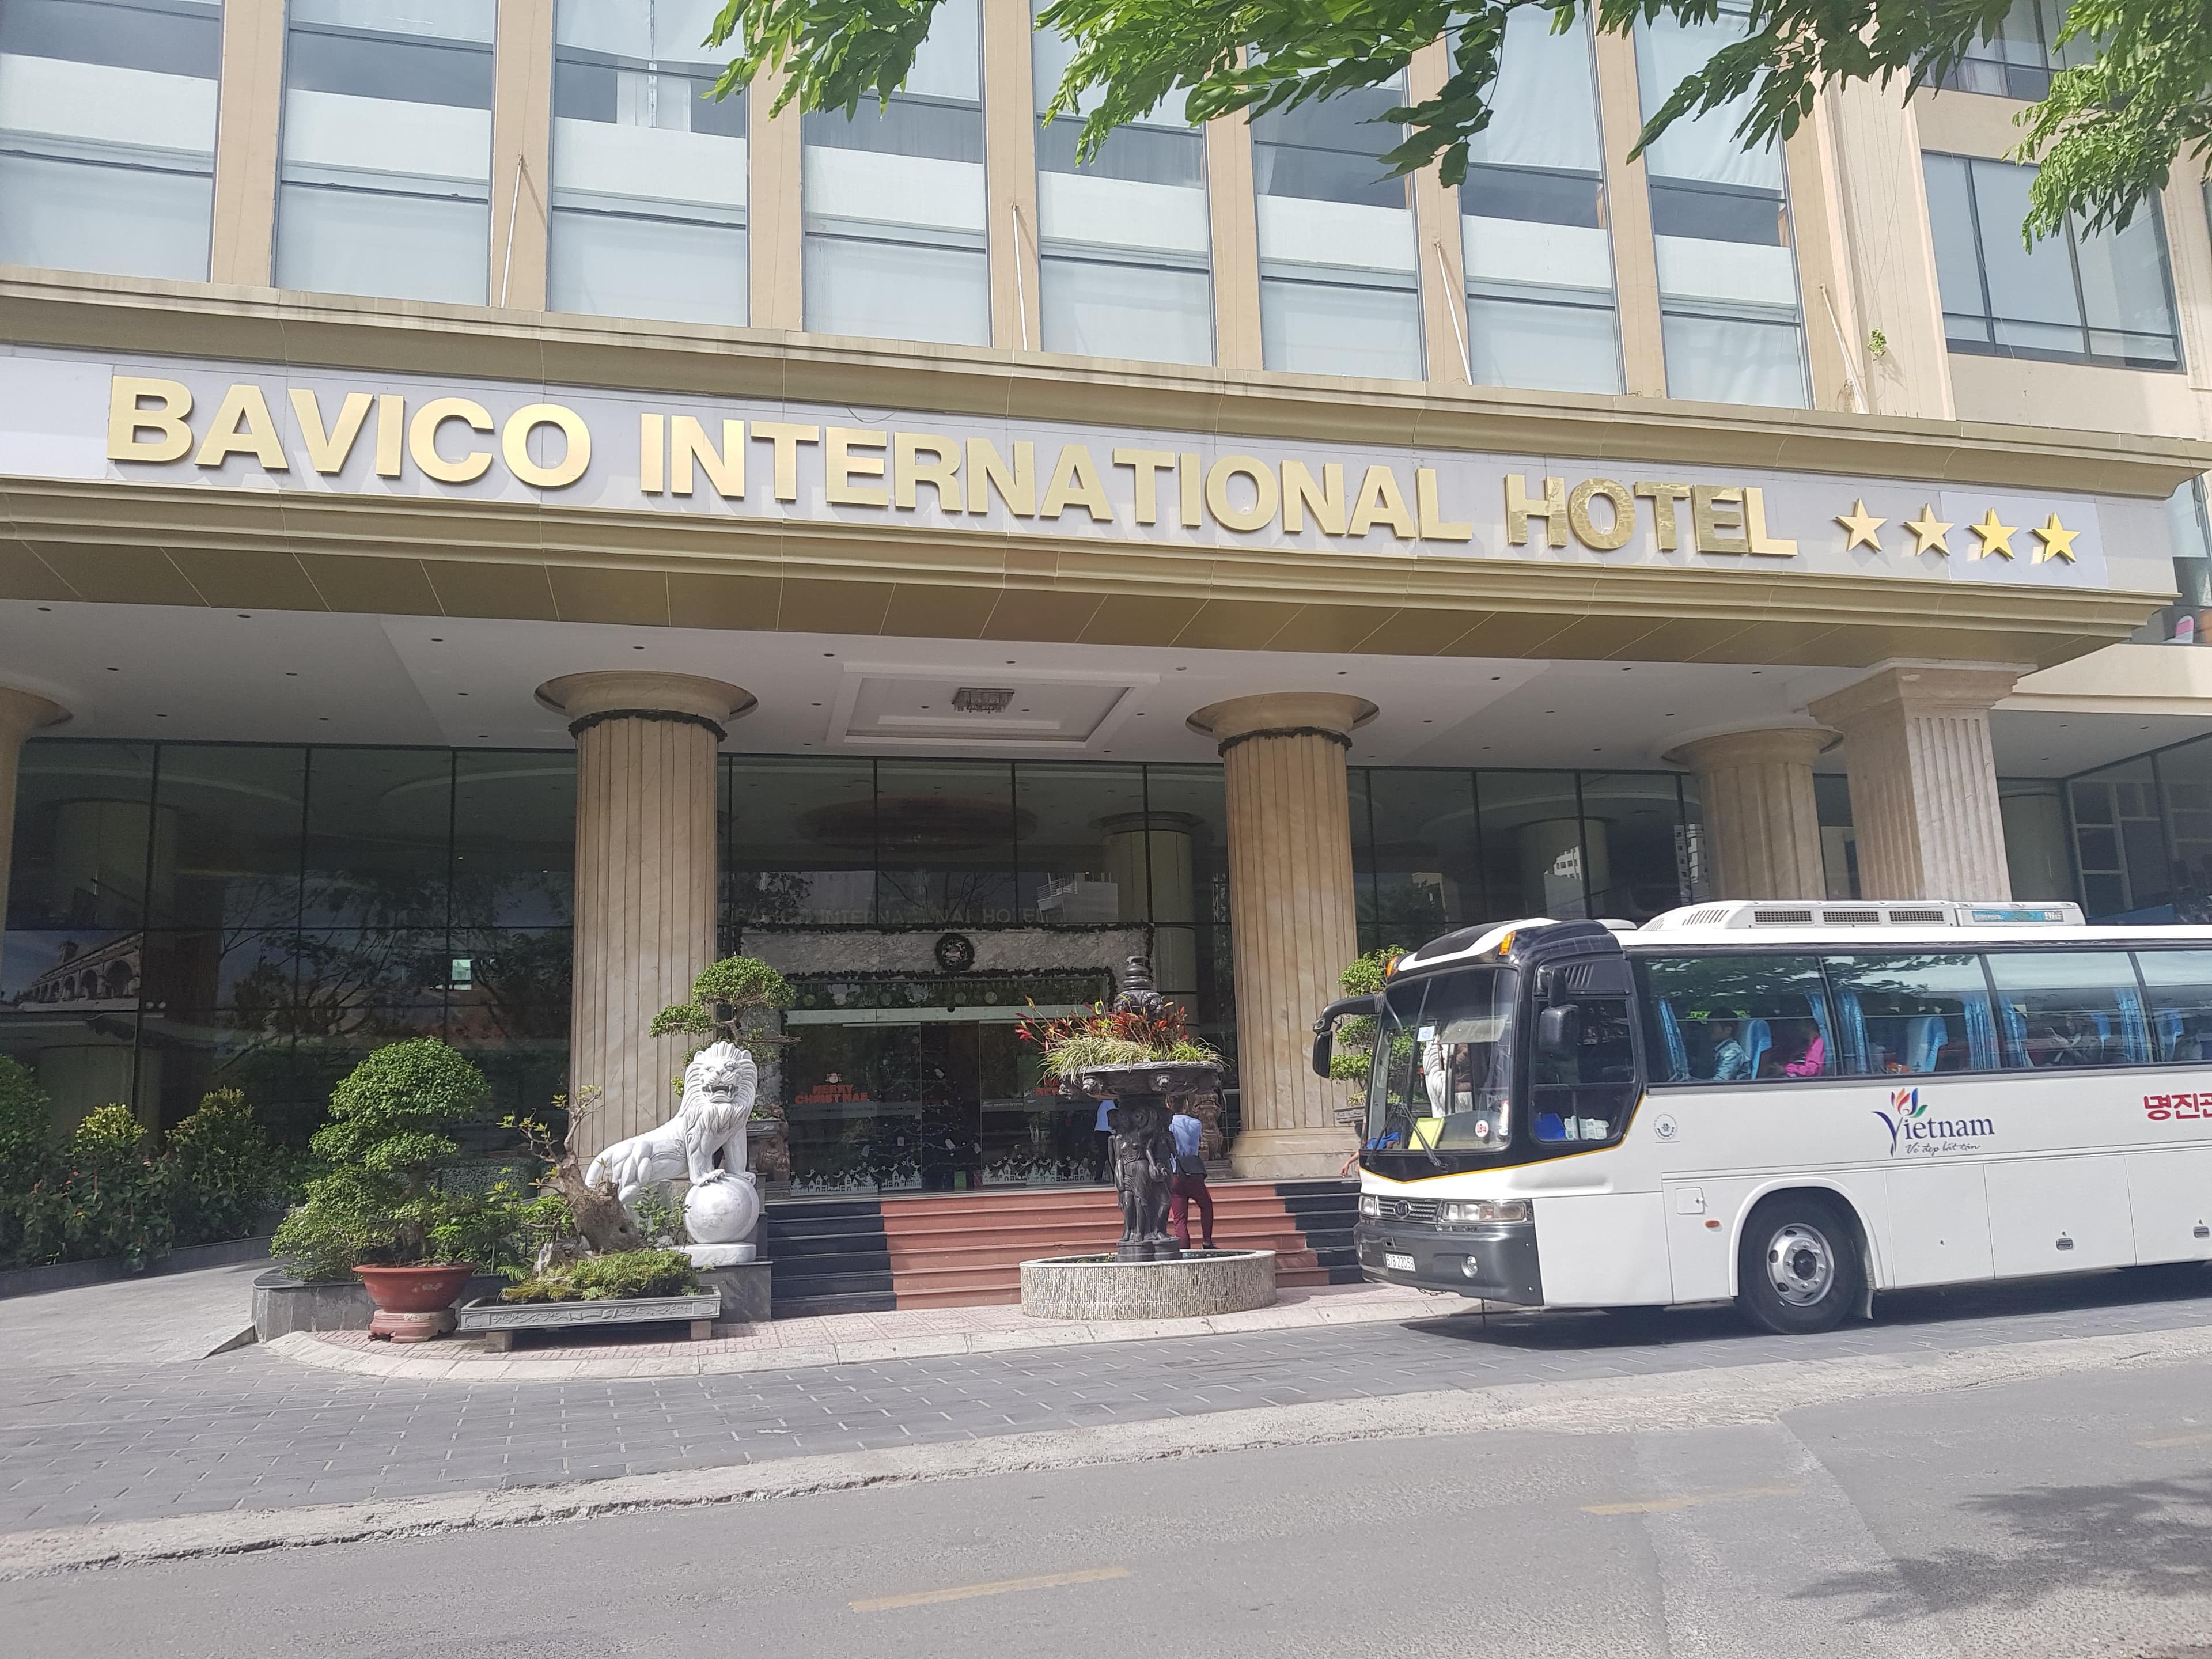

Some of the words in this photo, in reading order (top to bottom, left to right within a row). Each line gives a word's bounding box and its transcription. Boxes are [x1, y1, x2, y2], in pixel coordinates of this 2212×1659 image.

[107, 376, 592, 488] BAVICO
[640, 412, 1472, 541] INTERNATIONAL
[1504, 474, 1798, 556] HOTEL
[1871, 1111, 1996, 1157] Vietnam
